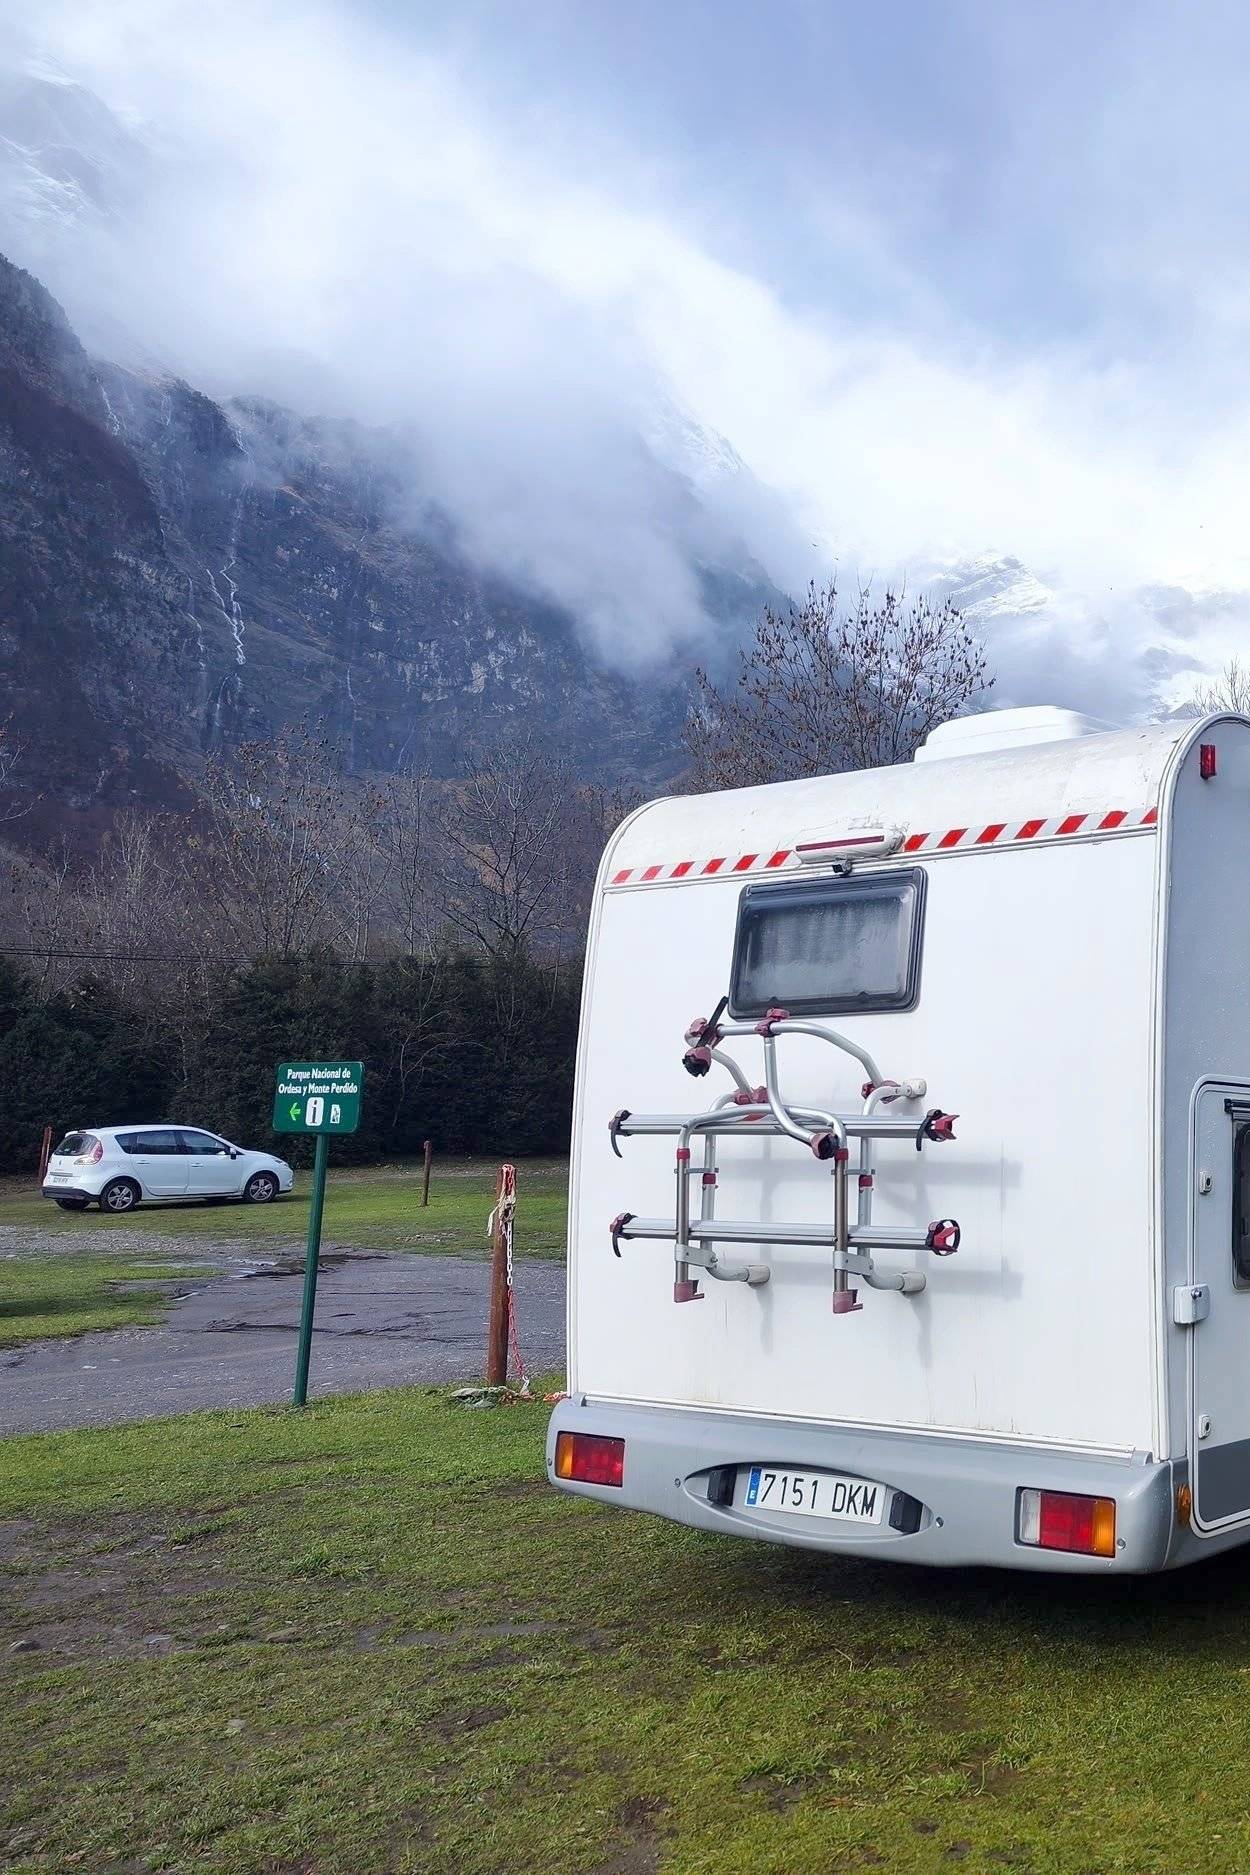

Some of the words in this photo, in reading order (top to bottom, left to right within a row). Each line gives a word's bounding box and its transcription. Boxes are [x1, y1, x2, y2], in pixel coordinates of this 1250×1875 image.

[287, 1069, 310, 1081] Parque
[312, 1068, 341, 1079] Nacional
[342, 1068, 351, 1078] de
[278, 1083, 302, 1094] Ordesa
[302, 1086, 307, 1096] y
[308, 1083, 330, 1093] Monte
[331, 1083, 358, 1093] Perdido
[749, 1490, 756, 1499] E
[761, 1473, 818, 1509] 7151
[832, 1483, 877, 1517] DKM
